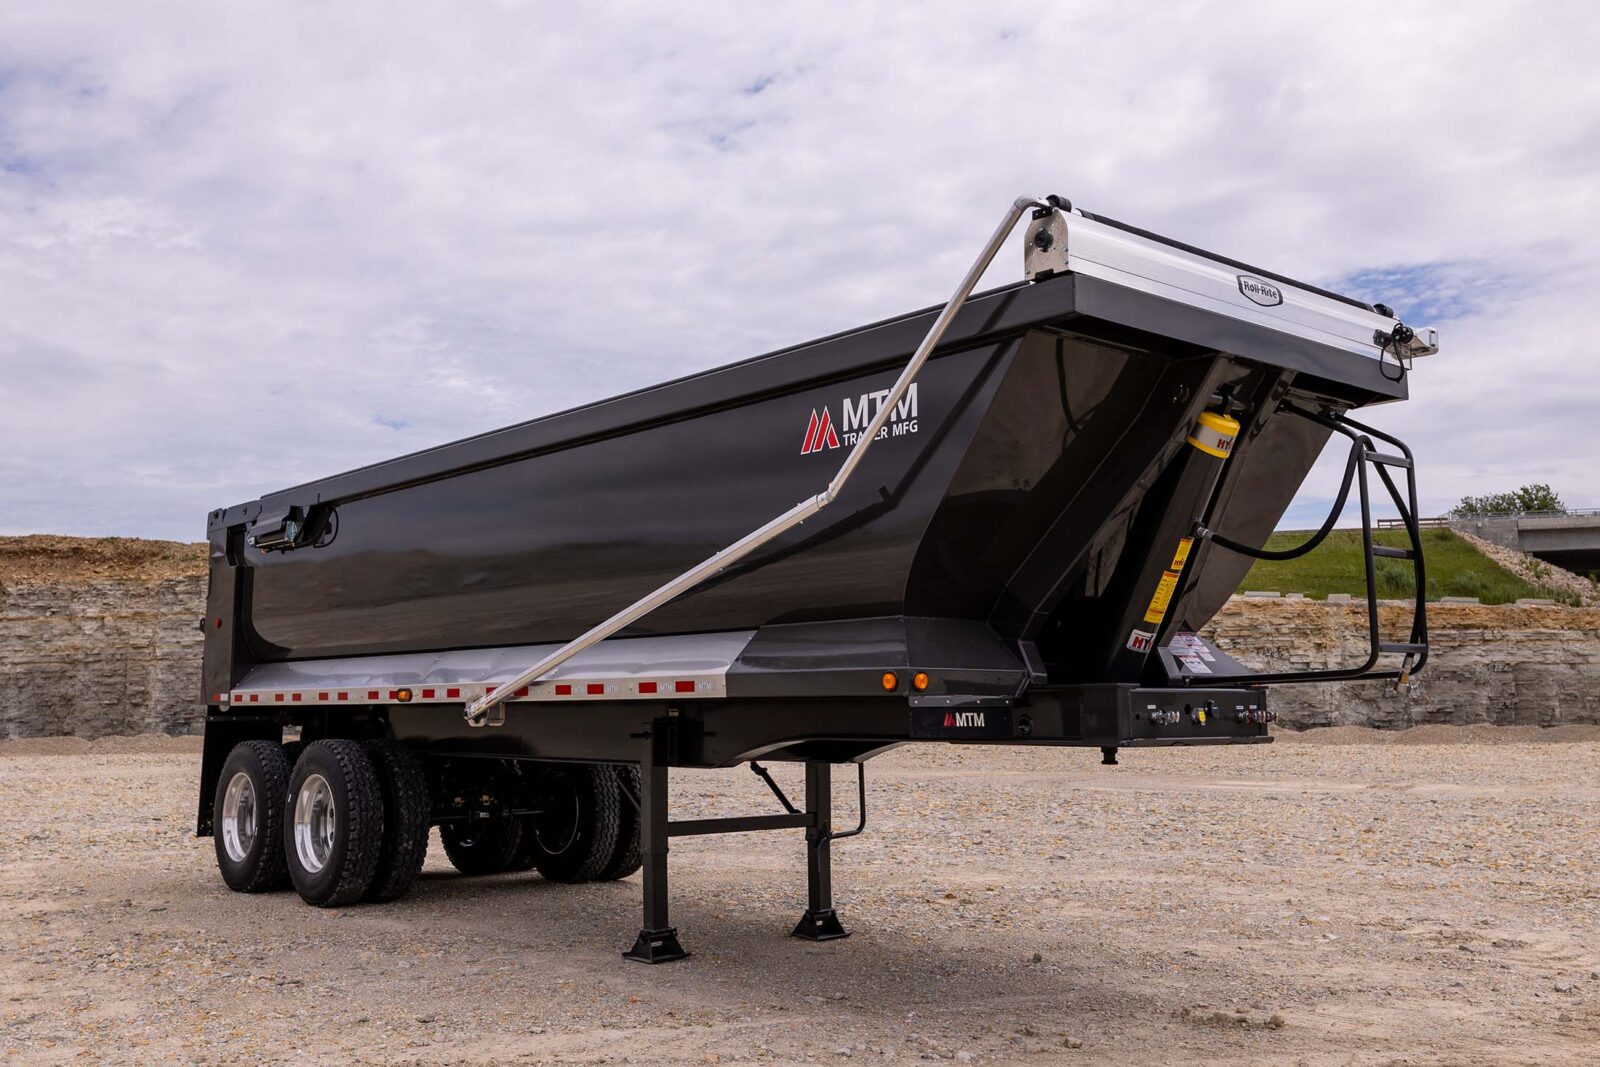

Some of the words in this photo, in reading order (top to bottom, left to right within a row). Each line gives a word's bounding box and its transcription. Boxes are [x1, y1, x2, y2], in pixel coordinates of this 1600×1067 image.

[1243, 280, 1278, 299] Roll-Rite
[842, 382, 918, 432] MTM
[842, 426, 888, 446] TRAR
[892, 420, 918, 437] MFG
[956, 711, 985, 727] MTM
